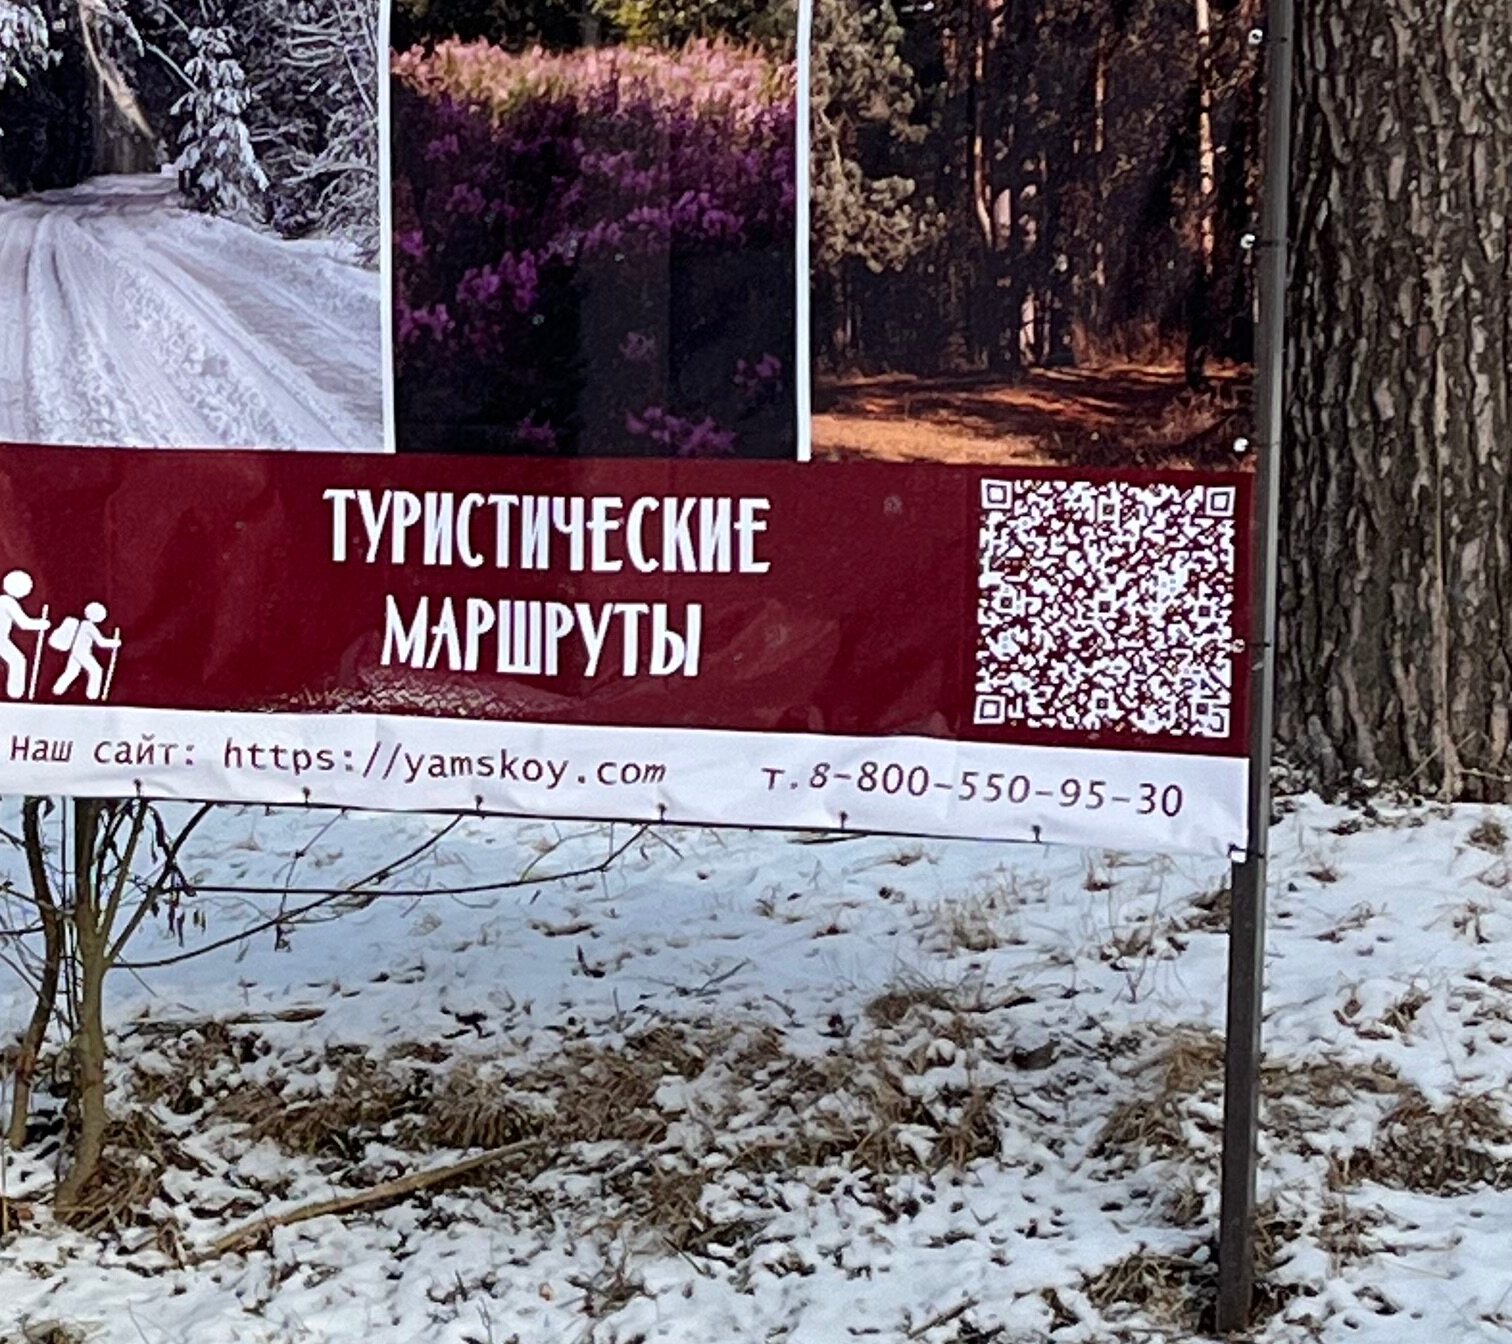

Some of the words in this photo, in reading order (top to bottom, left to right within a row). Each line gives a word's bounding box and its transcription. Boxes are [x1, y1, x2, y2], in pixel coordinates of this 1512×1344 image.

[322, 488, 771, 574] ТУРИСТИЧЕСКИЕ
[380, 595, 703, 677] МАРШРУТЫ
[10, 735, 73, 764] Наш
[93, 737, 197, 766] сайт:
[224, 737, 667, 789] https://yamskoy.com
